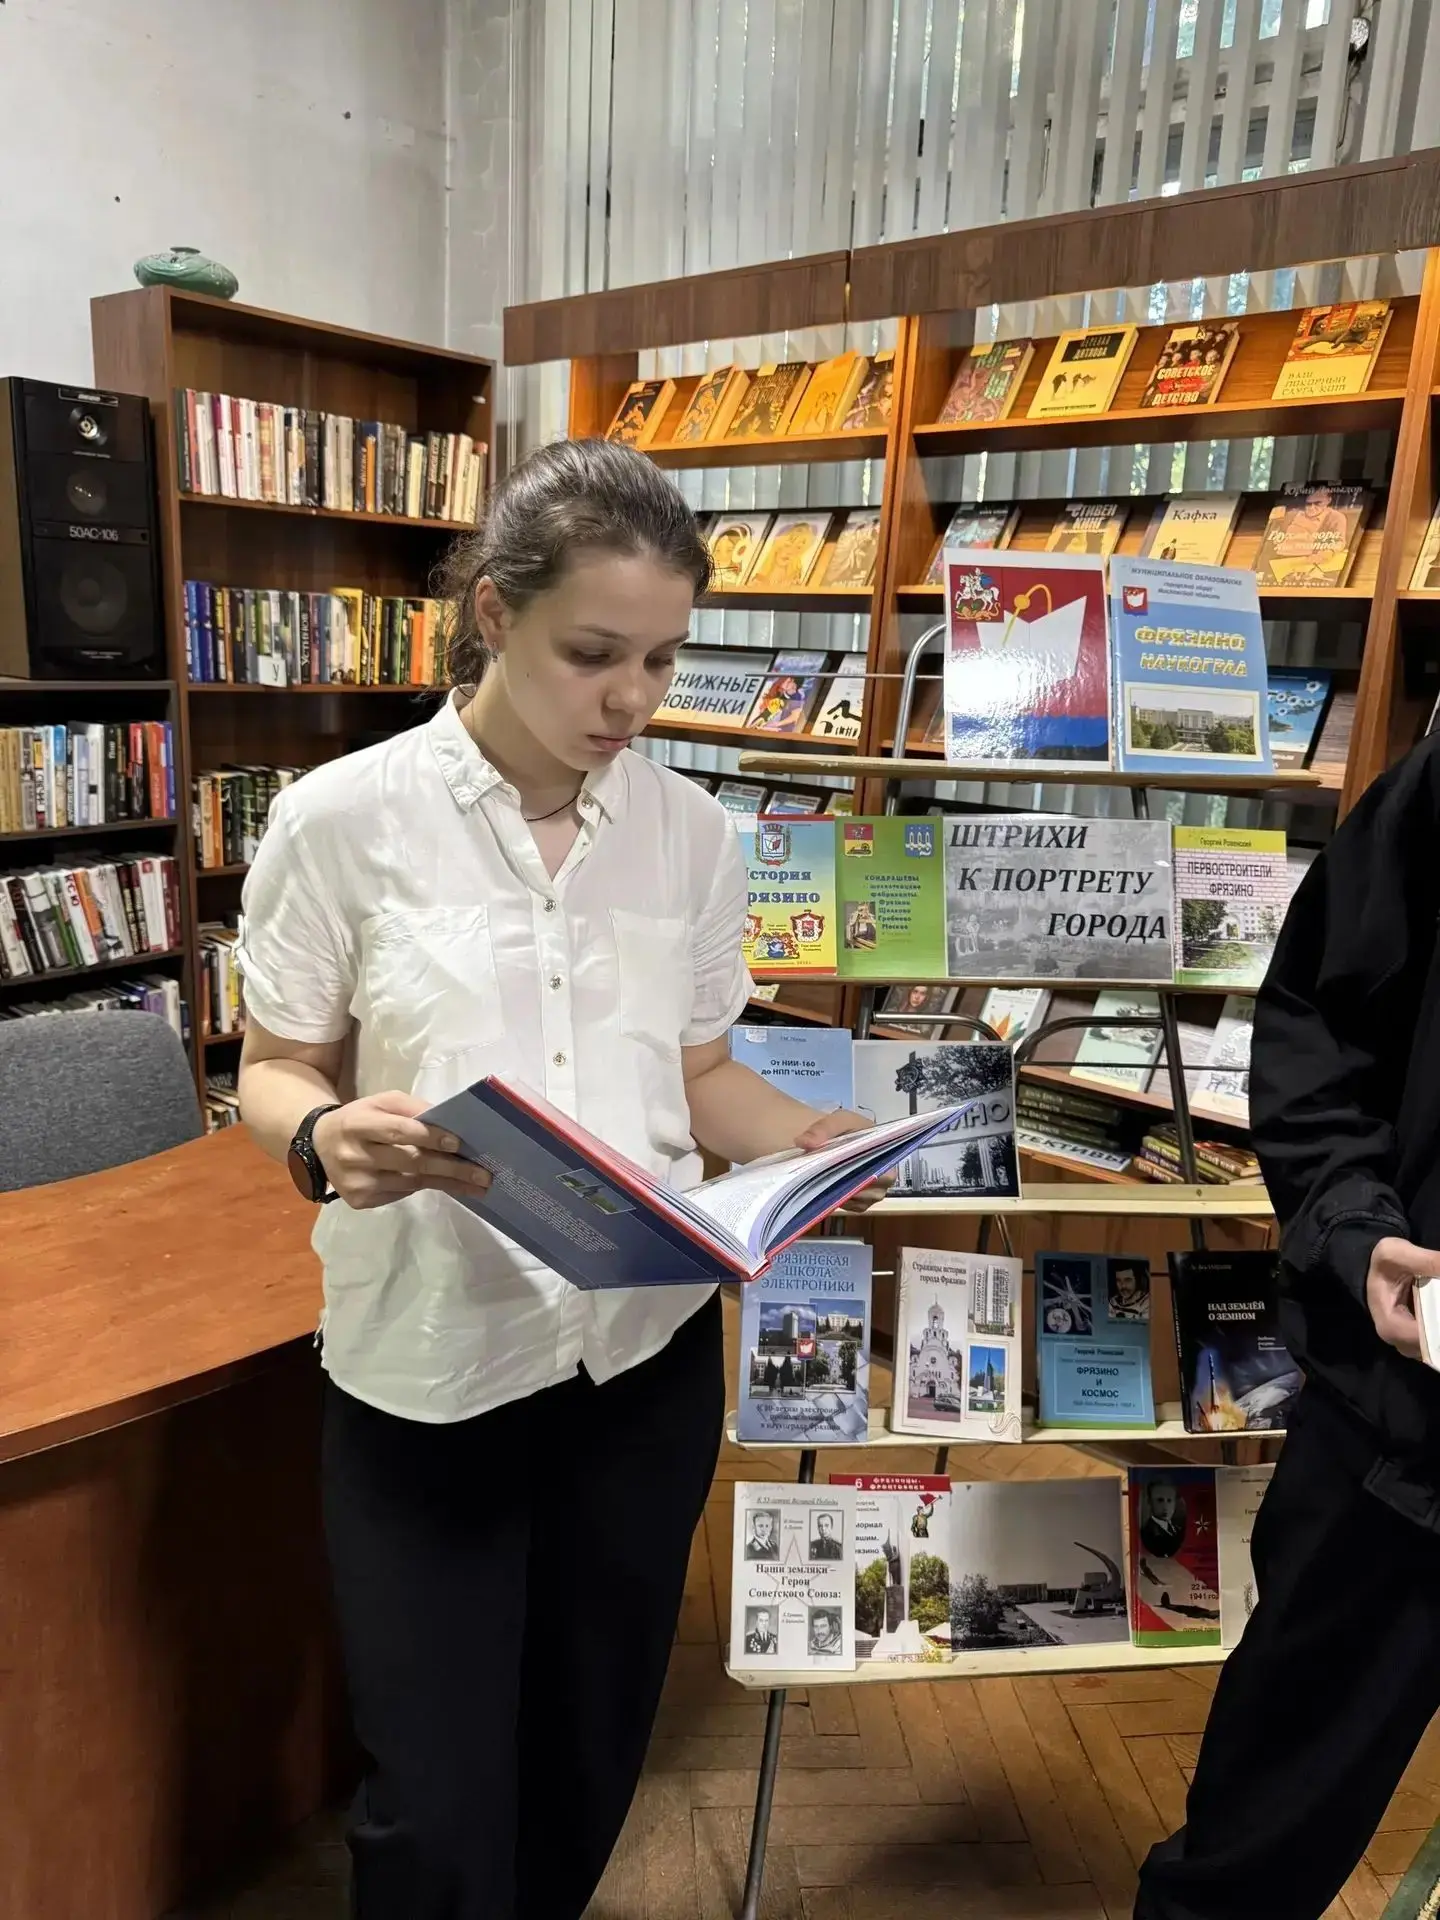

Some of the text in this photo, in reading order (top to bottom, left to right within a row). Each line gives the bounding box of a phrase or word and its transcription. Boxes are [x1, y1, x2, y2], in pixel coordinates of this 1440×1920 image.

[1157, 364, 1216, 380] СОВЕТСКОЕ
[1285, 376, 1346, 388] ПОКОРНЫЙ
[1152, 391, 1199, 406] ДЕТСТВО
[1071, 504, 1118, 517] СТИВЕН
[1172, 509, 1217, 524] Кафка
[1073, 517, 1105, 530] КИНГ
[1131, 567, 1242, 586] МУНИЦИПАЛЬНОЕ ОБРАЗОВАНИЕ
[1135, 626, 1246, 652] ФРЯЗИНО
[1140, 652, 1248, 677] НАУКОГРАД
[671, 672, 759, 693] НИЖНЫЕ
[950, 824, 1089, 849] ШТРИХИ
[1187, 861, 1272, 877] ПЕРВОСТРОИТЕЛИ
[958, 868, 1154, 894] К ПОРТРЕТУ
[1209, 883, 1254, 897] ФРЯЗИНО
[748, 892, 820, 907] рязино
[1047, 913, 1167, 945] ГОРОДА
[791, 1069, 824, 1077] "ИСТОК"
[784, 1265, 832, 1278] ШКОЛА
[912, 1261, 967, 1276] Страницы истории
[761, 1278, 855, 1293] ЭЛЕКТРОНИКИ
[920, 1275, 967, 1287] города Фрязино
[1208, 1301, 1265, 1312] НАД ЗЕМЛЁЙ
[1208, 1312, 1256, 1321] О ЗЕМНОМ
[1076, 1366, 1119, 1376] ФРЯЗИНО
[1081, 1388, 1119, 1398] КОСМОС
[855, 1478, 863, 1489] 6
[756, 1563, 785, 1574] Наши
[787, 1566, 828, 1574] земляки
[781, 1576, 810, 1588] Герои
[748, 1587, 841, 1599] Советского Союза:
